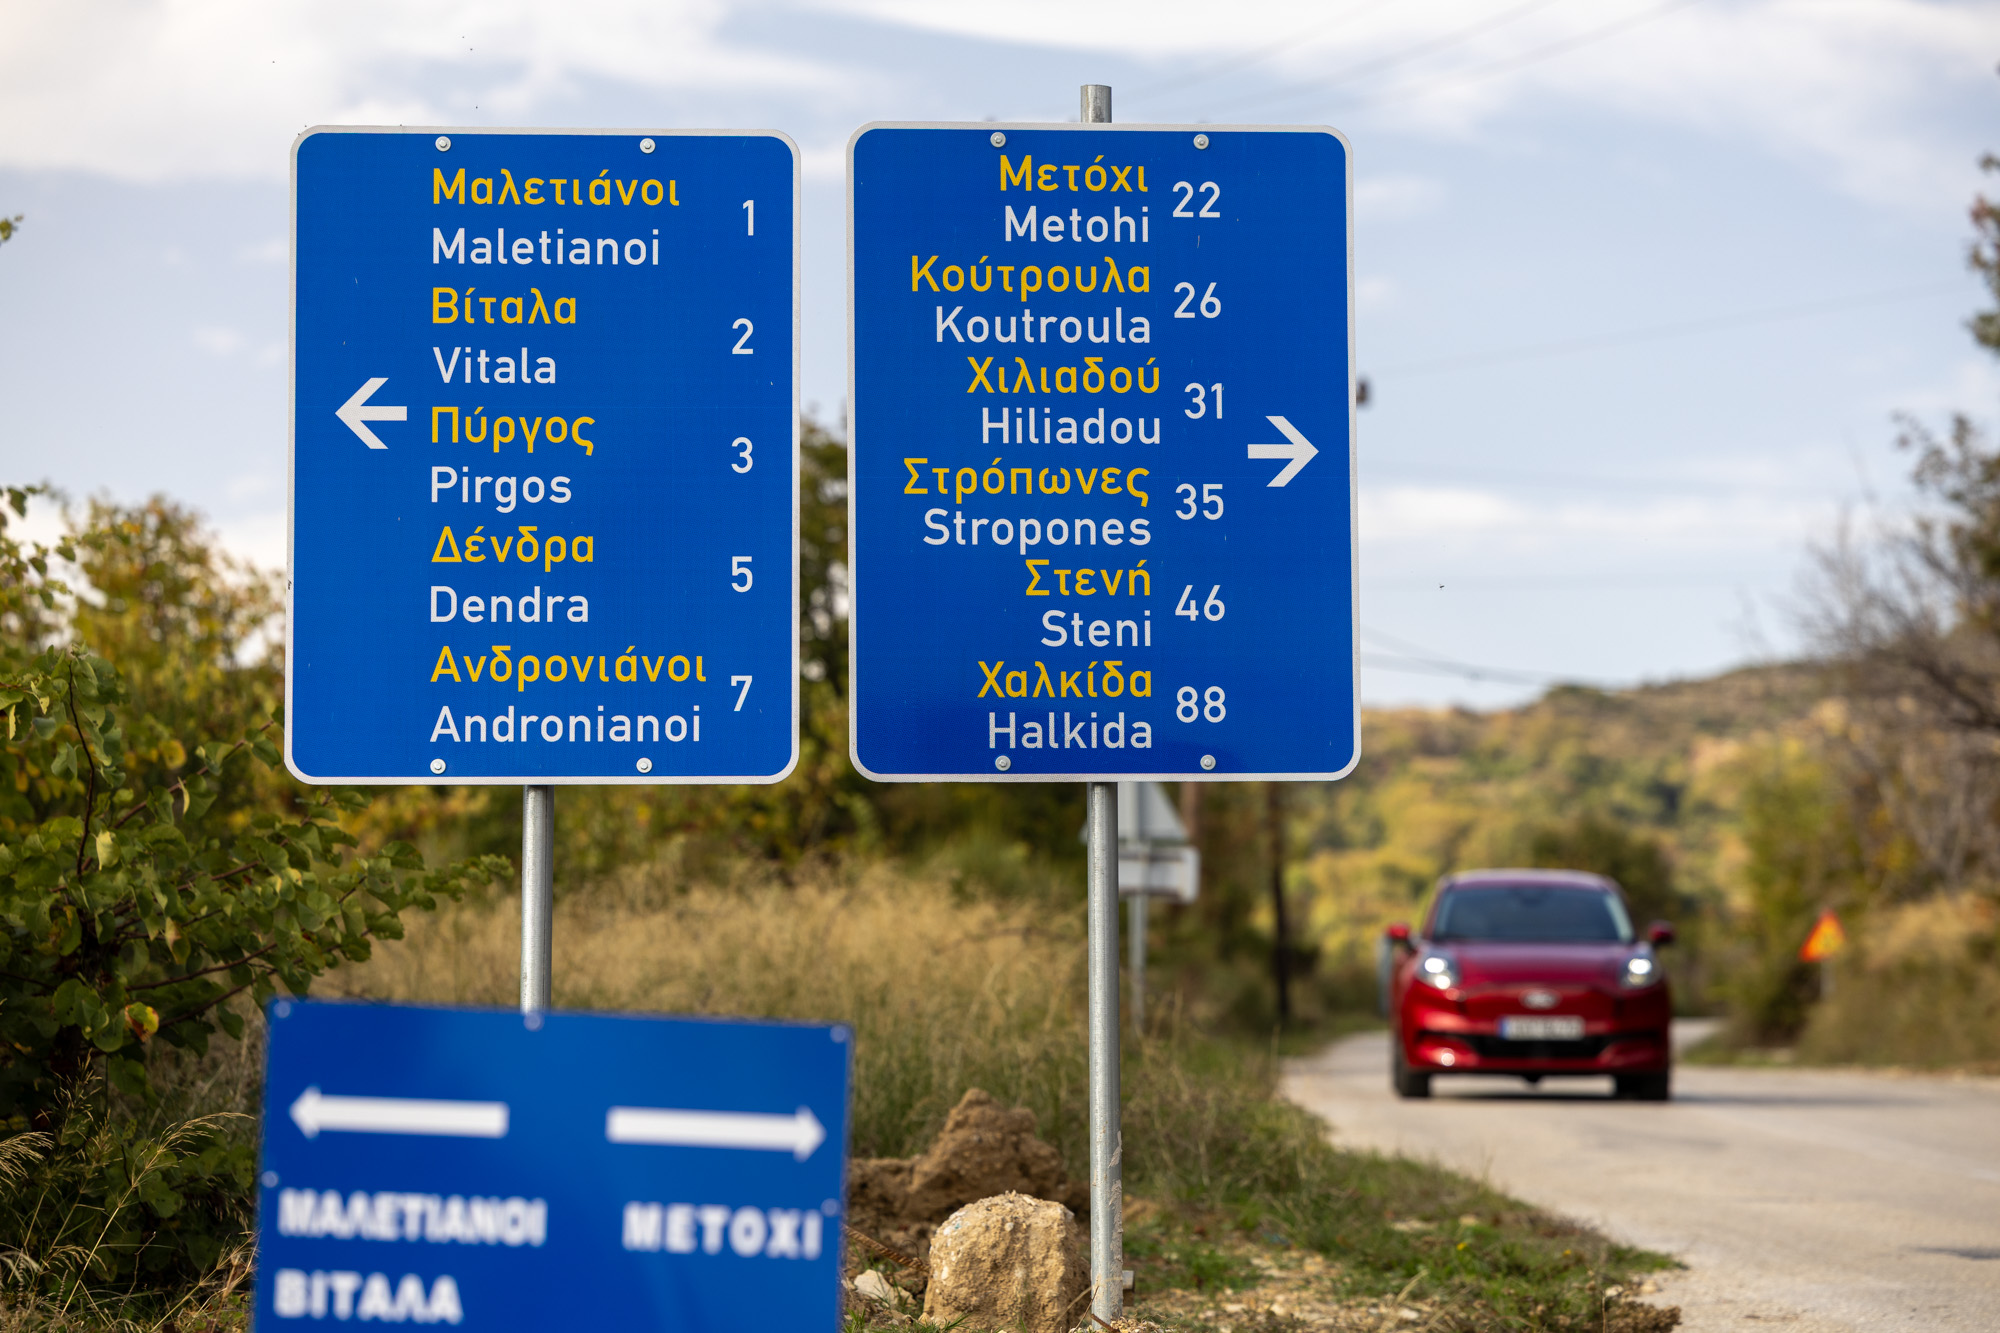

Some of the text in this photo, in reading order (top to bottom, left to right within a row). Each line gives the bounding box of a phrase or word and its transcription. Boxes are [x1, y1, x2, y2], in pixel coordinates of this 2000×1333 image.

[432, 168, 680, 206] Μαλετιάνοι
[1002, 156, 1148, 192] Μετόχι
[742, 200, 755, 236] 1
[1173, 181, 1221, 218] 22
[1005, 207, 1149, 243] Metohi
[433, 229, 659, 266] Maletianoi
[912, 256, 1150, 302] Κούτρουλα
[432, 288, 577, 324] Βίταλα
[1174, 282, 1222, 319] 26
[731, 318, 754, 355] 2
[936, 306, 1150, 344] Koutroula
[433, 347, 557, 384] Vitala
[967, 357, 1160, 394] Χιλιαδού
[1184, 383, 1224, 420] 31
[432, 407, 595, 456] Πύργος
[982, 408, 1161, 445] Hiliadou
[731, 437, 754, 474] 3
[431, 466, 572, 514] Pirgos
[904, 458, 1149, 508] Στρόπωνες
[1175, 484, 1225, 521] 35
[431, 526, 594, 573] Δένδρα
[924, 509, 1152, 556] Stropones
[731, 556, 753, 593] 5
[1025, 560, 1151, 597] Στενή
[430, 586, 589, 624] Dendra
[1174, 585, 1226, 622] 46
[1041, 610, 1151, 648] Steni
[431, 646, 707, 692] Ανδρονιάνοι
[977, 661, 1152, 698] Χαλκίδα
[730, 676, 753, 712] 7
[1175, 686, 1227, 724] 88
[430, 705, 700, 743] Andronianoi
[989, 712, 1152, 749] Halkida
[277, 1189, 548, 1247] ΜΑΛΕΤΙΑΝΟΙ
[622, 1203, 823, 1260] ΜΕΤΟΧΙ
[274, 1269, 463, 1325] ΒΙΤΑΛΑ
